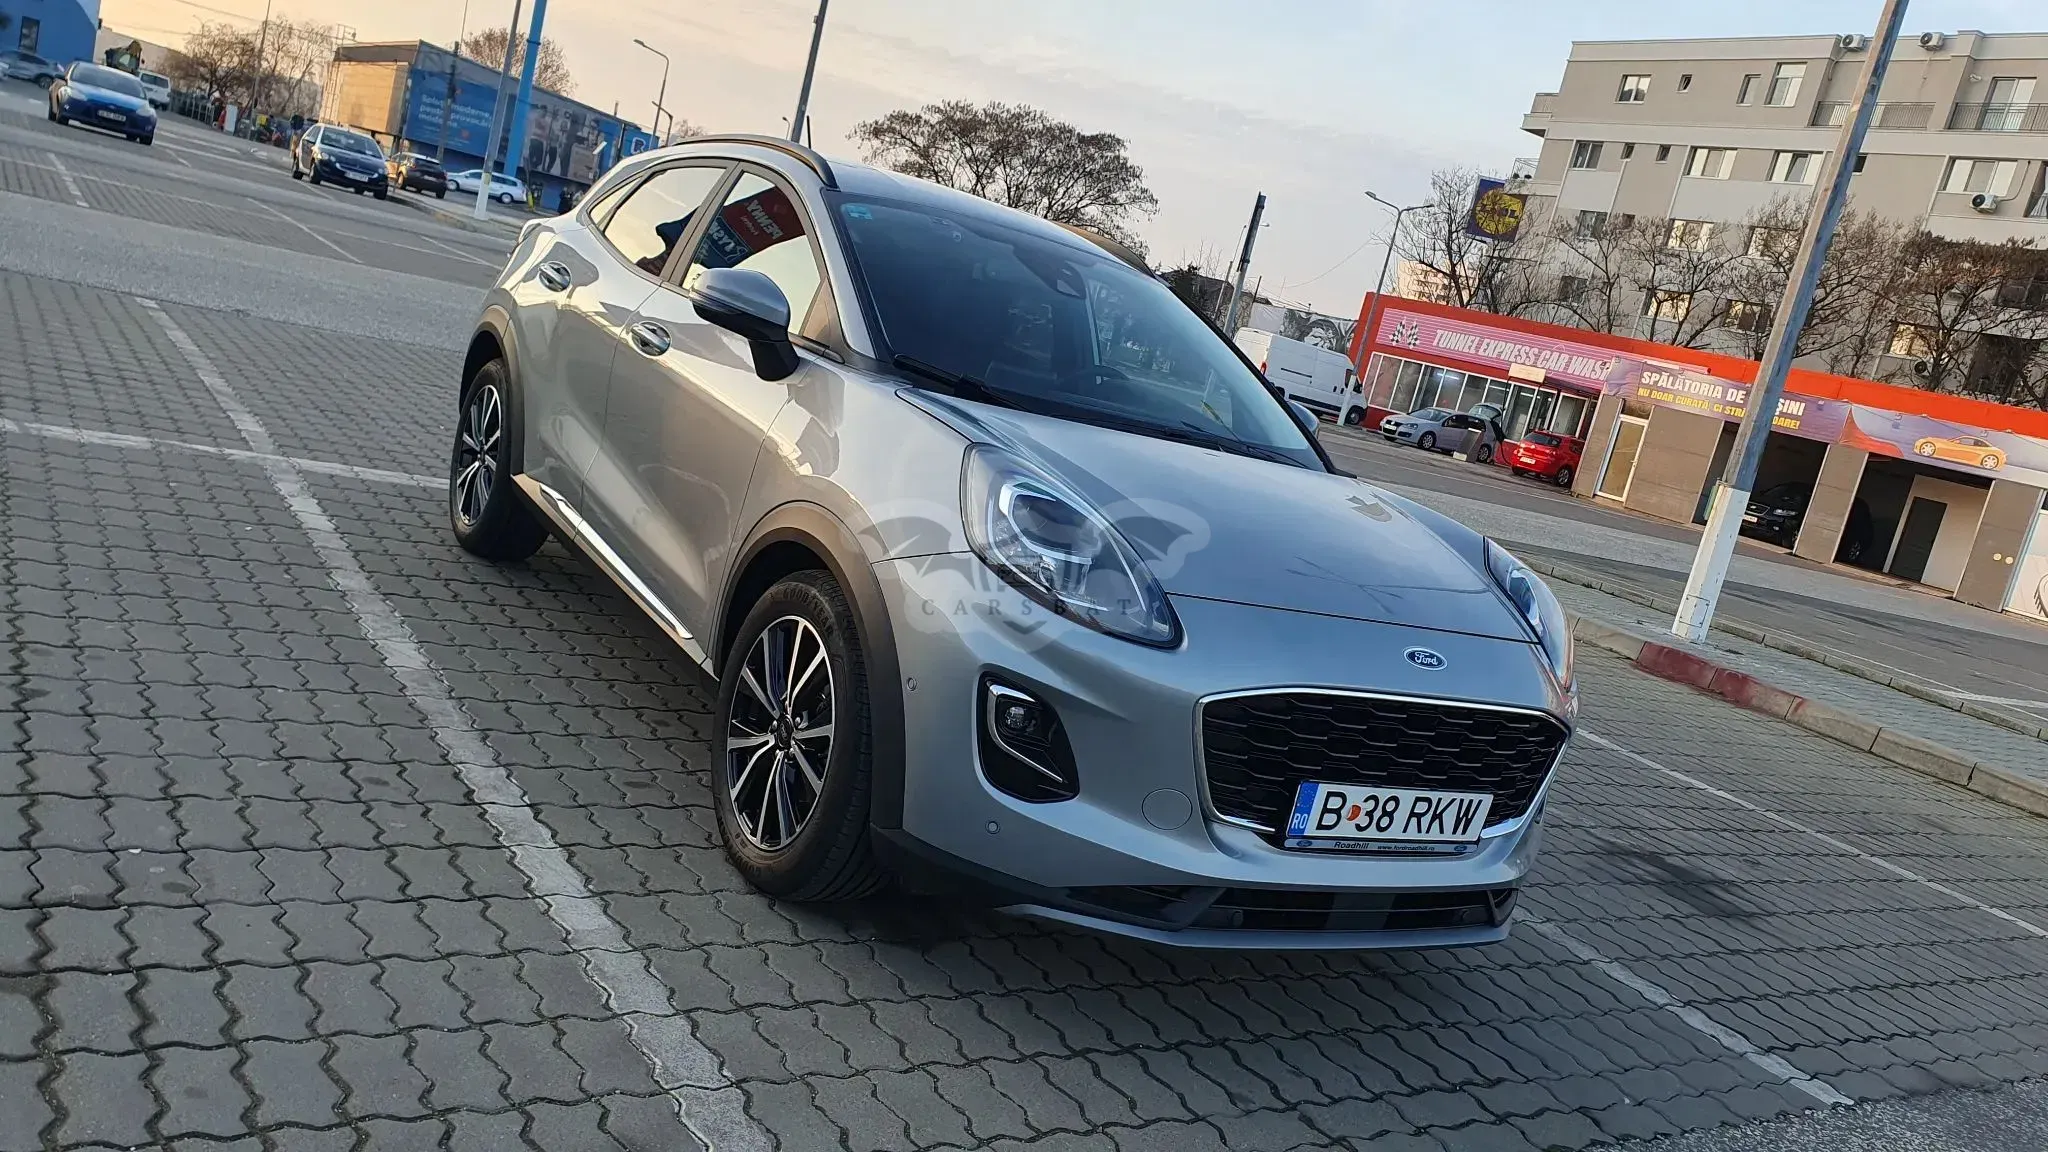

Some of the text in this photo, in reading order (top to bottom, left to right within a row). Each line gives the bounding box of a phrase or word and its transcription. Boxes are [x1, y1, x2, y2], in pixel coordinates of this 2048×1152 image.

[1433, 329, 1478, 354] TUNNEL
[1480, 338, 1538, 365] EXPRESS
[1537, 351, 1569, 372] CAR
[1637, 387, 1649, 397] NU
[1650, 390, 1673, 403] DOAR
[1713, 402, 1723, 413] CI
[1641, 371, 1806, 416] SPĂLĂTORIA DE ȘINI
[1414, 651, 1439, 666] Ford
[1291, 813, 1308, 829] RO
[1316, 790, 1482, 836] B 38 RKW
[1334, 841, 1370, 850] Roadhill
